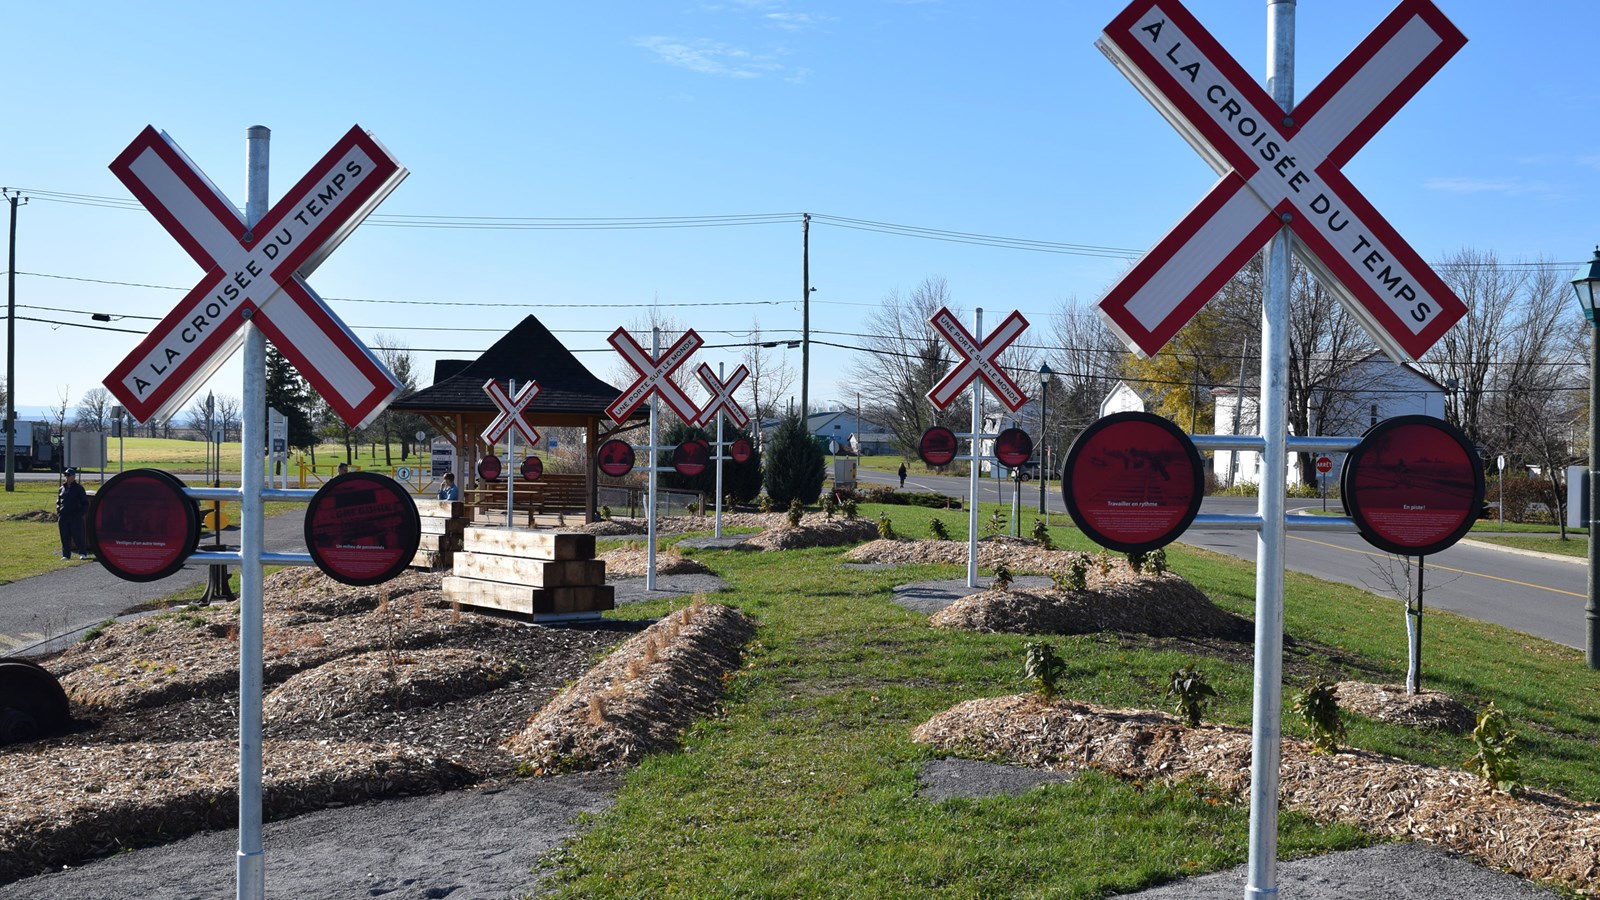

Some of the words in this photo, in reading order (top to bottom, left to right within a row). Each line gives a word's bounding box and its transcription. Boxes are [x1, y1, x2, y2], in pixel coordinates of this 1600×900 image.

[1141, 19, 1165, 43] À
[1166, 42, 1201, 83] LA
[1206, 84, 1310, 193] CROISÉE
[1309, 193, 1349, 232] DU
[1351, 235, 1431, 323] TEMPS
[133, 376, 151, 395] À
[150, 347, 180, 376] LA
[181, 260, 263, 344] CROISÉE
[262, 228, 293, 260] DU
[294, 160, 362, 227] TEMPS
[615, 401, 630, 416] UNE
[628, 382, 650, 403] PORTE
[649, 368, 663, 383] SUR
[662, 360, 672, 370] LE
[672, 340, 694, 361] MONDE
[940, 316, 955, 333] UNE
[954, 331, 976, 356] PORTE
[974, 354, 989, 372] SUR
[987, 368, 998, 381] LE
[997, 377, 1019, 404] MONDE
[502, 411, 517, 428] JARDIN
